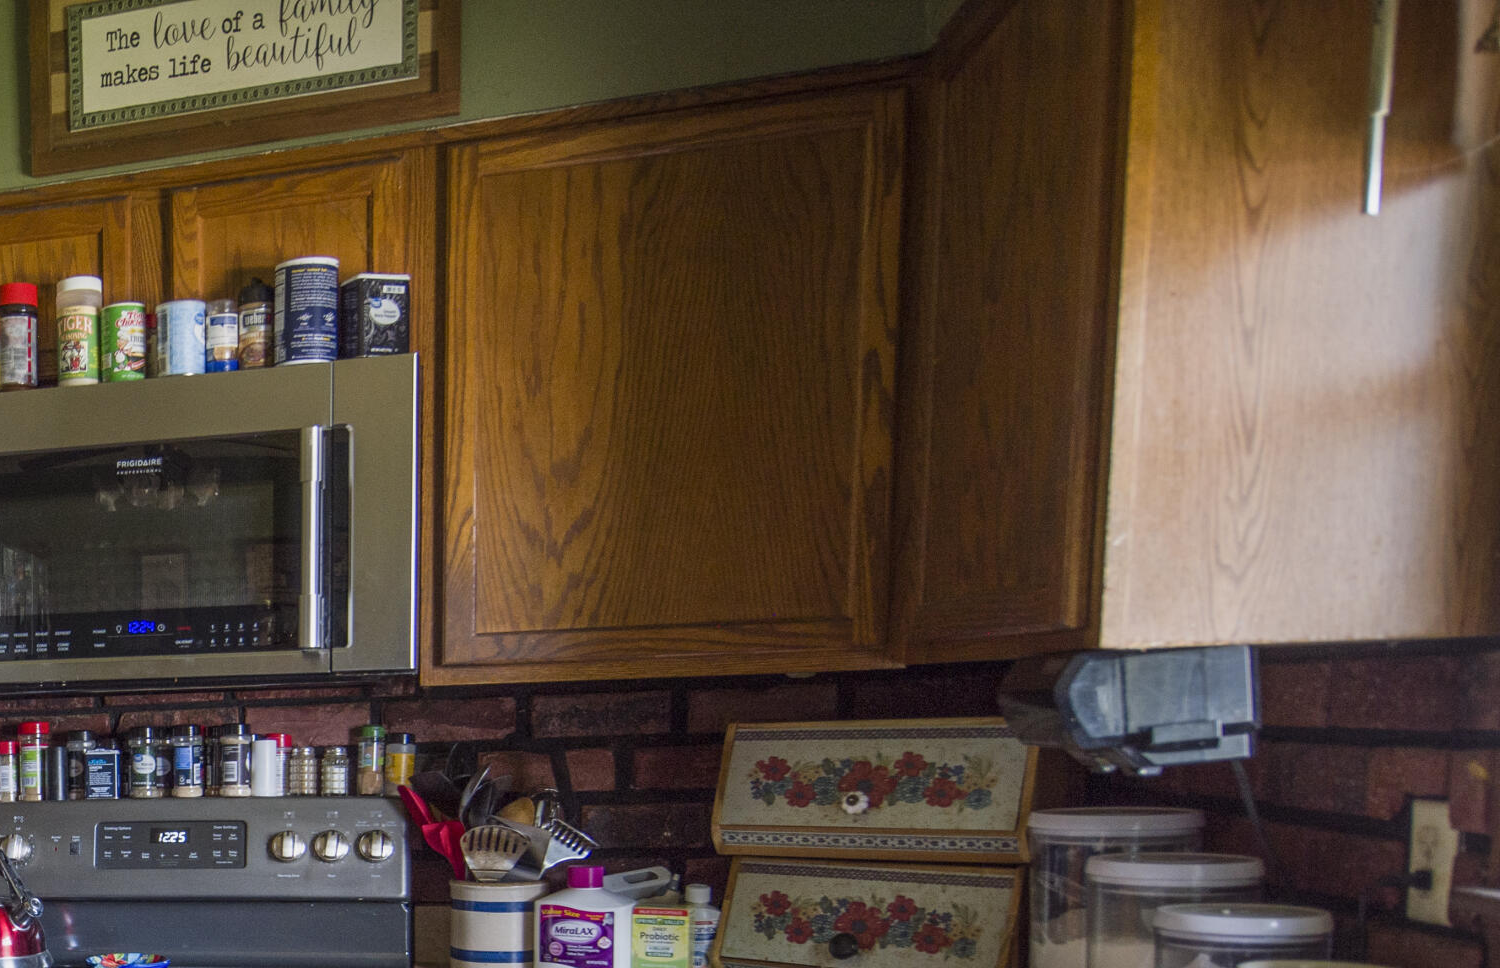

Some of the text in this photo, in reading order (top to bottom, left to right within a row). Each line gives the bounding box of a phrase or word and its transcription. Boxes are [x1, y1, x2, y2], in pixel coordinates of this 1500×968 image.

[106, 0, 379, 53] The love of a family
[100, 17, 362, 88] makes life beautiful
[116, 457, 162, 468] FRIGIDAIRE
[554, 926, 594, 935] MiraLAX
[640, 931, 680, 941] Probiotic
